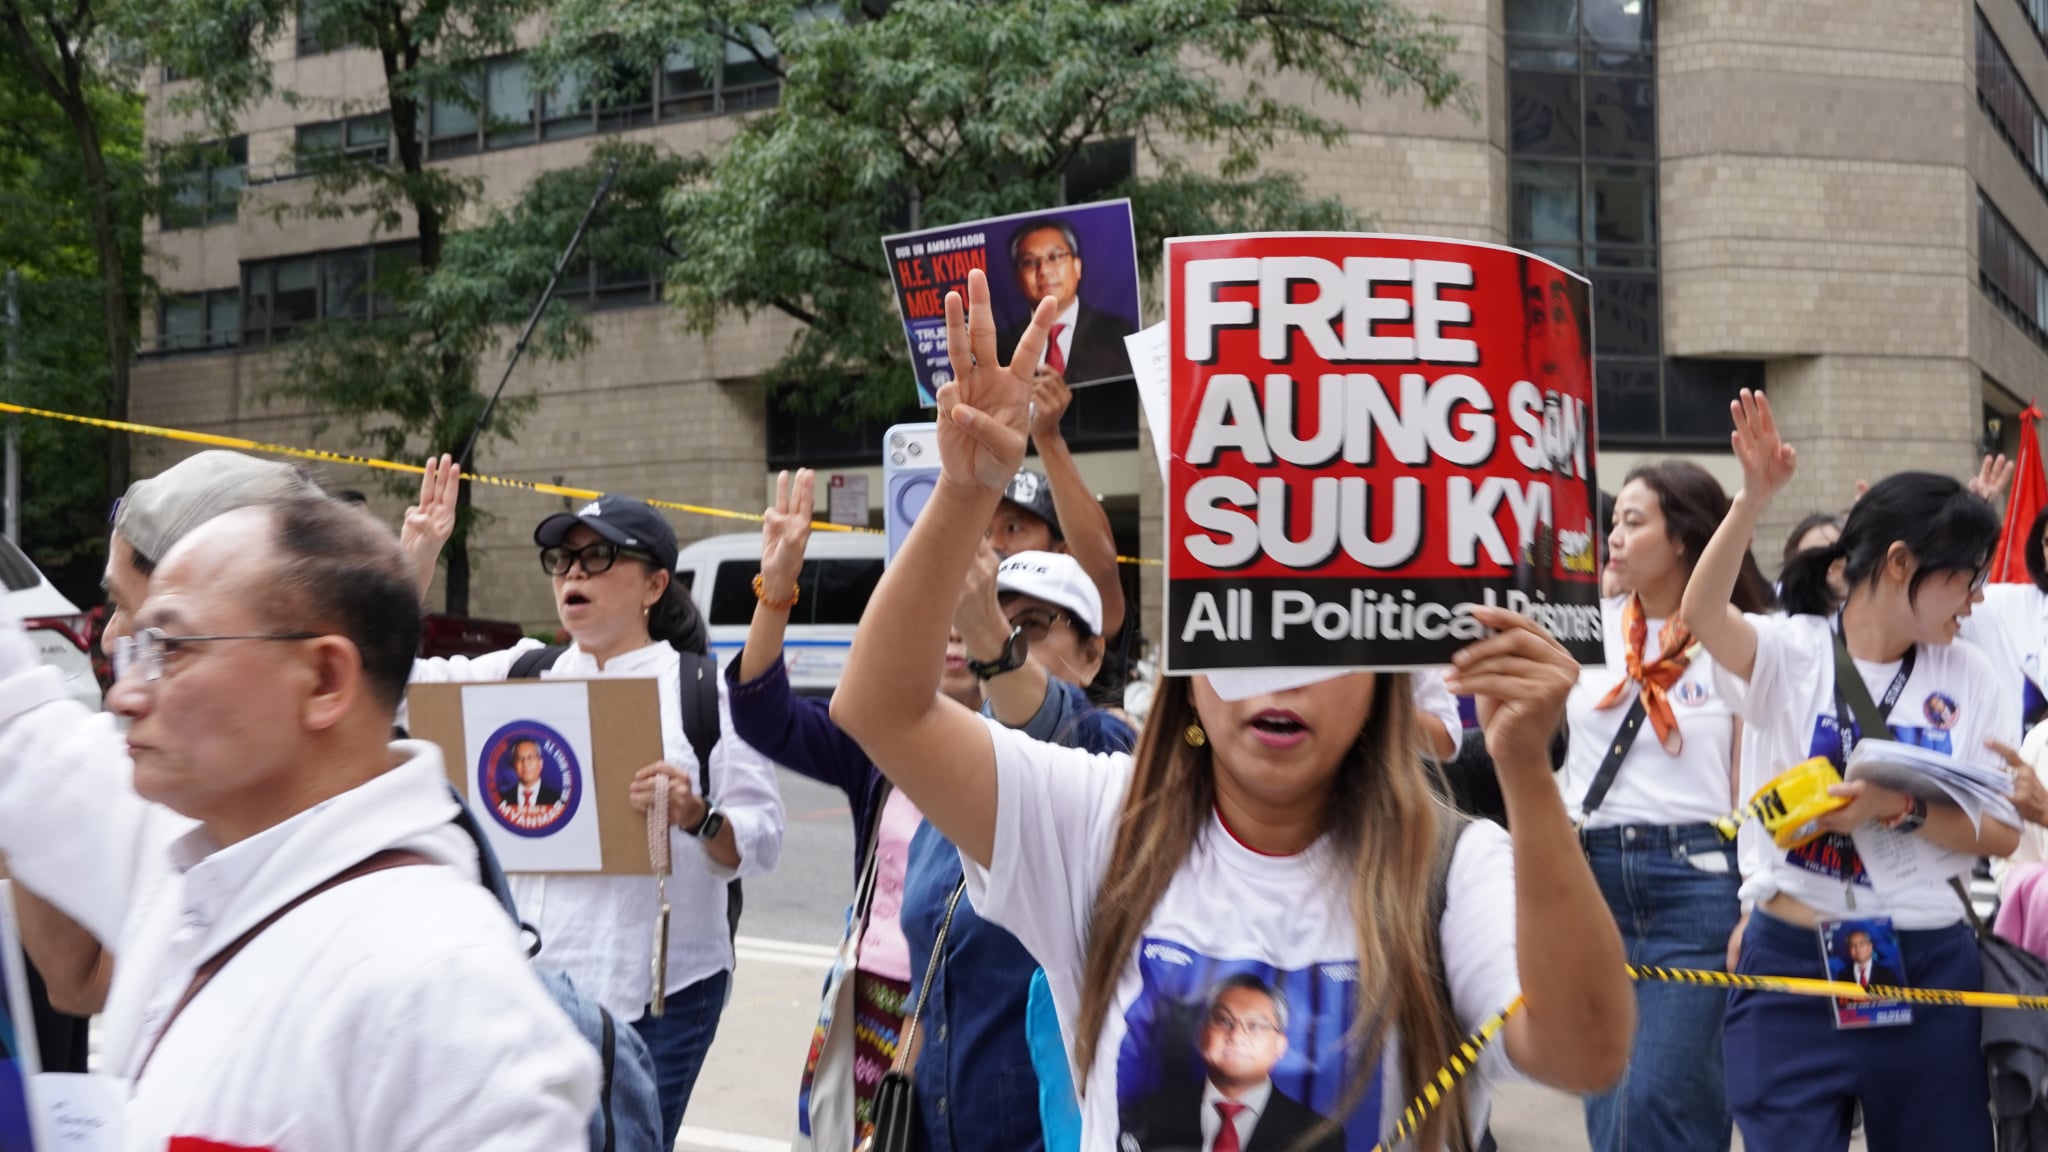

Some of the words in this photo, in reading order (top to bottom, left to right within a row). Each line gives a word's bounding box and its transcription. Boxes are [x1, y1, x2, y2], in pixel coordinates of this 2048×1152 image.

[895, 246, 912, 259] OUR
[912, 243, 925, 257] UN
[926, 232, 986, 254] AMBASSADOR
[897, 258, 931, 288] H.E.
[905, 287, 944, 319] MOE
[1184, 256, 1479, 364] FREE
[1185, 373, 1496, 467] AUNG
[1507, 380, 1588, 480] SAN
[1184, 475, 1422, 568] SUU
[1181, 588, 1253, 642] All
[1271, 587, 1498, 642] Political
